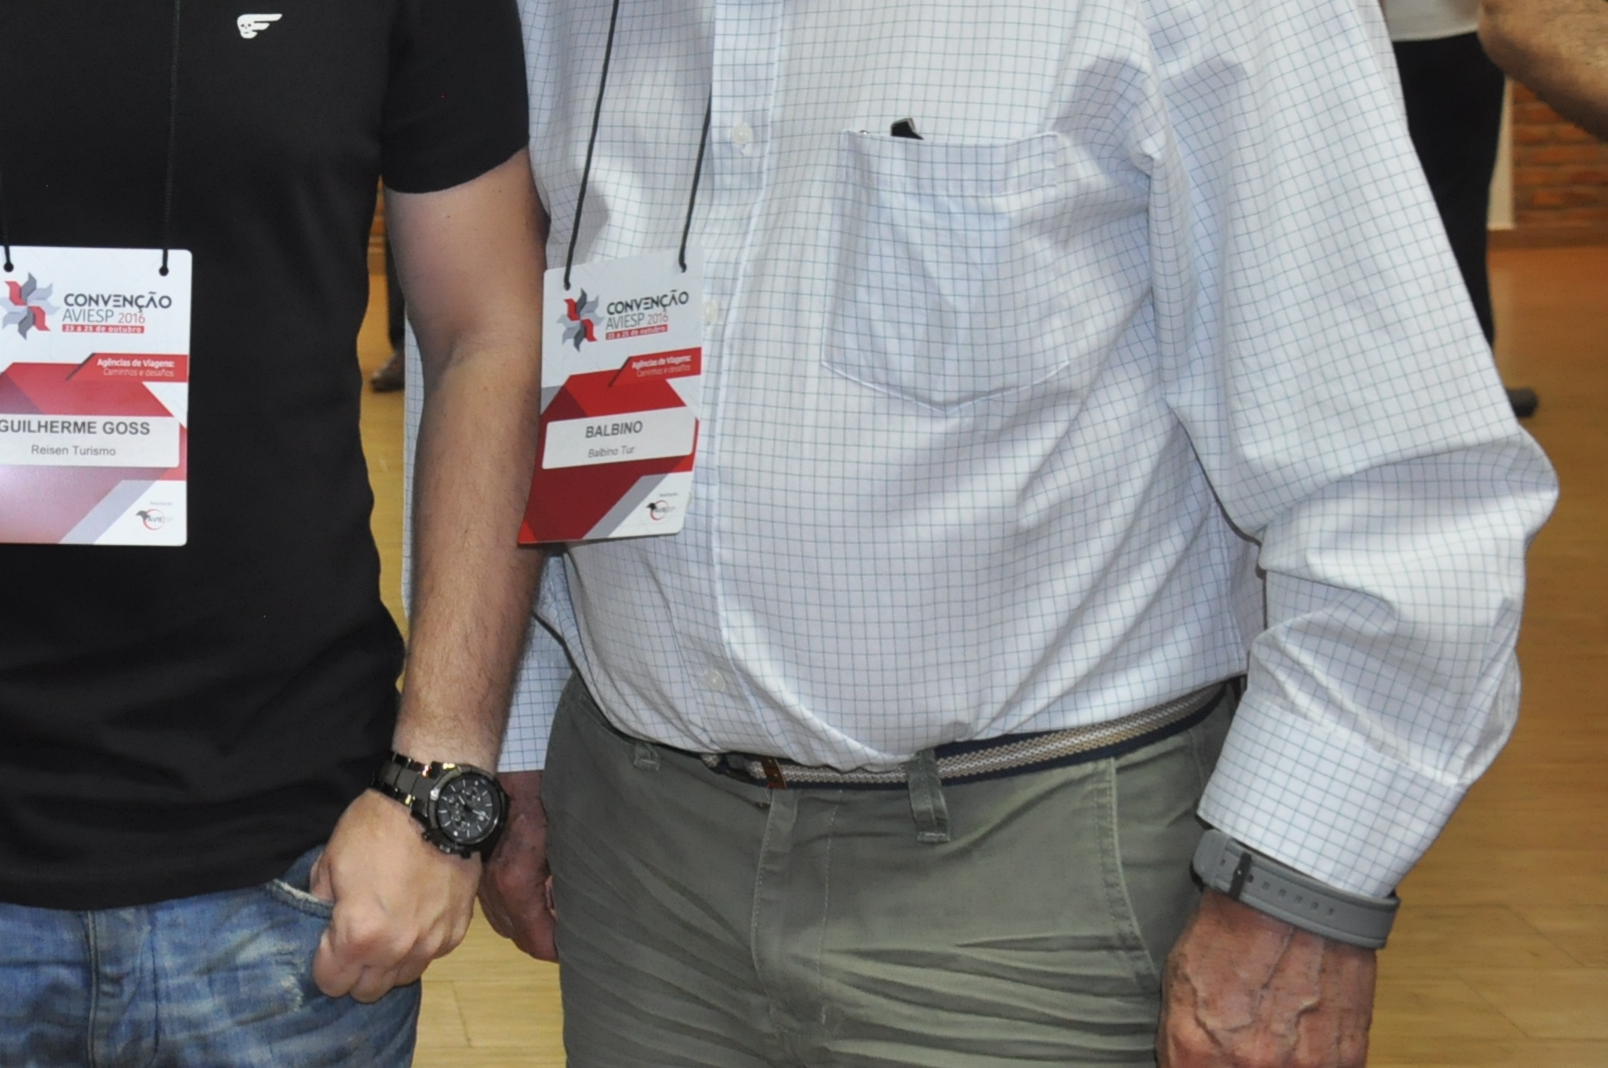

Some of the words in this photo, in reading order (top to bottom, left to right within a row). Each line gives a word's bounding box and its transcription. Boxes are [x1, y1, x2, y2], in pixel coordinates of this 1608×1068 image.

[63, 291, 172, 313] CONVENÇÃO
[607, 289, 689, 315] CONVENÇÃO
[62, 308, 114, 323] AVIESP
[118, 312, 146, 324] 2016
[606, 312, 645, 330] AVIESP
[647, 312, 669, 325] 2016
[108, 325, 142, 333] outubro
[97, 358, 131, 369] Agências
[132, 359, 142, 367] de
[102, 421, 150, 435] GOSS
[585, 420, 643, 438] BALBINO
[31, 444, 69, 455] Reisen
[72, 445, 116, 456] Turismo
[588, 448, 619, 458] Balbino
[621, 445, 635, 455] Tur
